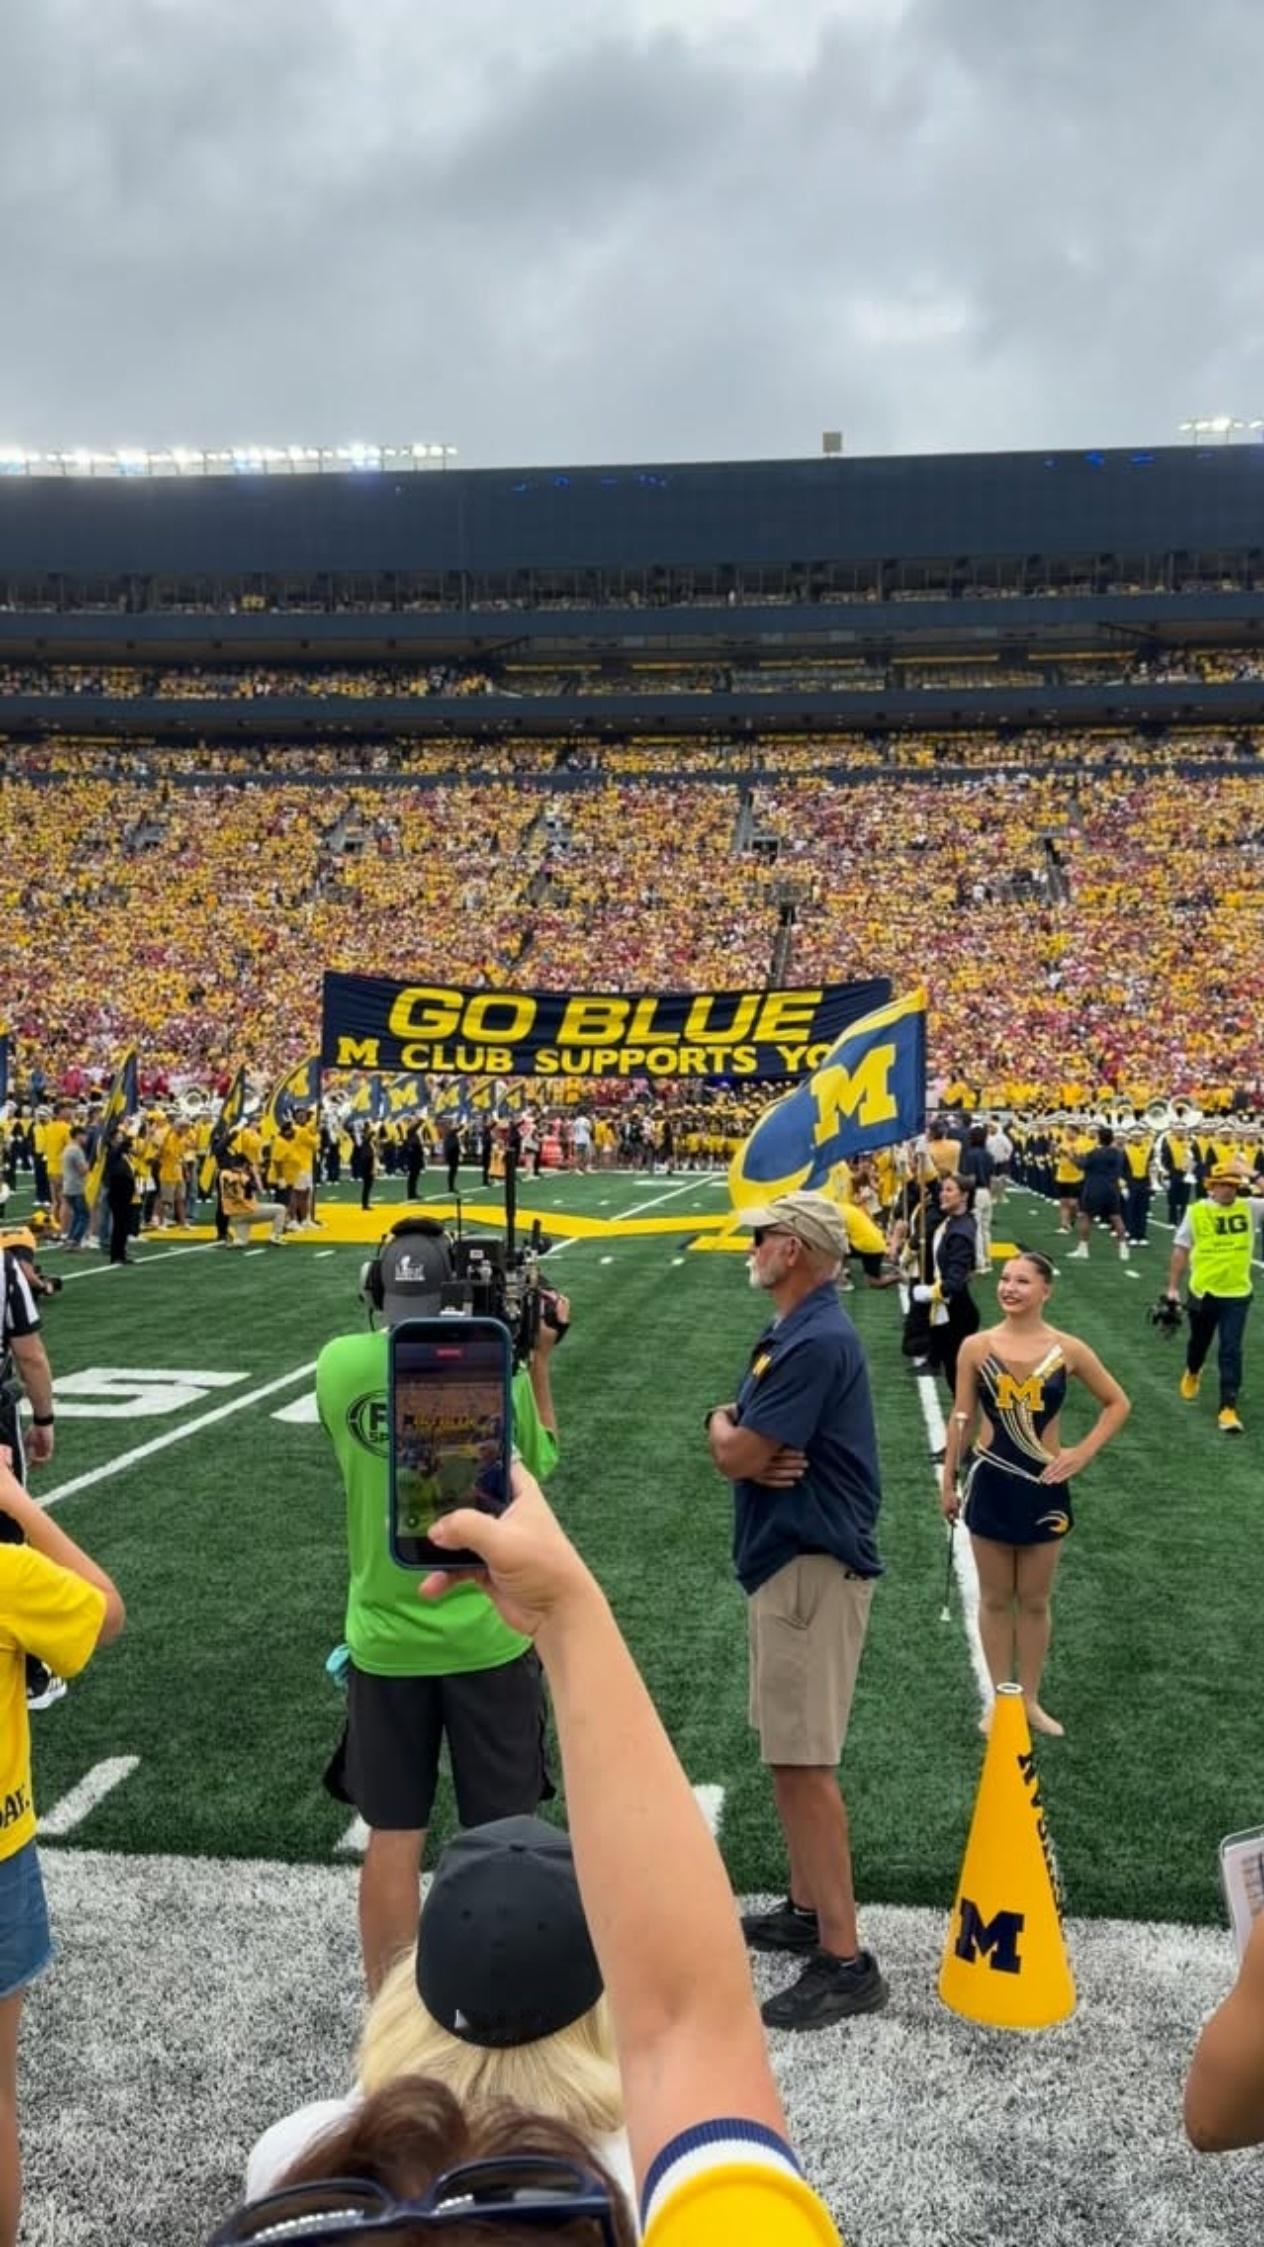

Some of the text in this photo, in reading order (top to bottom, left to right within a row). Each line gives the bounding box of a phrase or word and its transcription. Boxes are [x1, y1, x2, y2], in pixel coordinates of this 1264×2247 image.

[388, 986, 823, 1046] GO BLUE
[336, 1036, 833, 1075] M CLUB SUPPORTS YO
[810, 1044, 898, 1147] M
[995, 1372, 1045, 1412] M
[954, 1897, 1025, 1975] M
